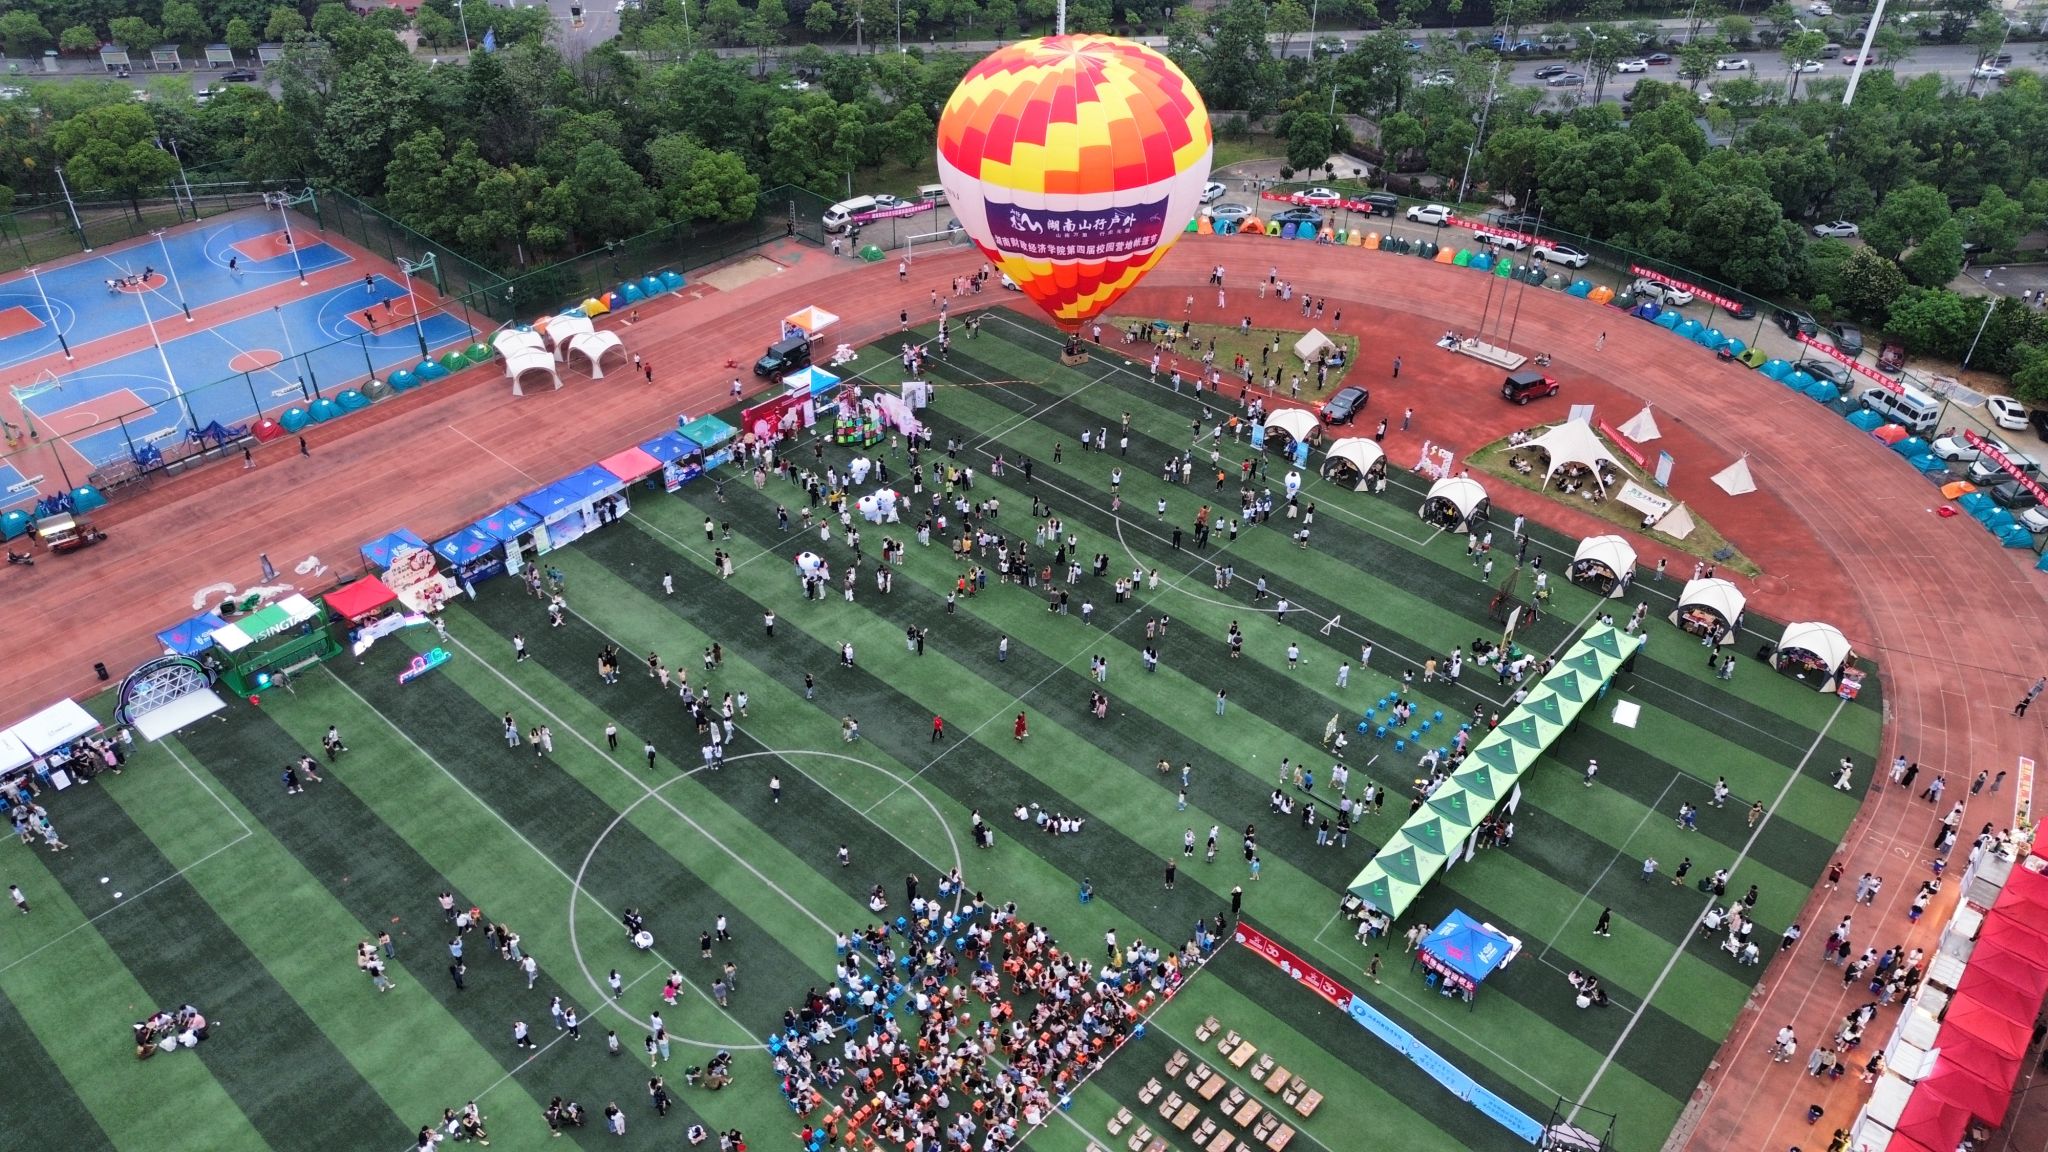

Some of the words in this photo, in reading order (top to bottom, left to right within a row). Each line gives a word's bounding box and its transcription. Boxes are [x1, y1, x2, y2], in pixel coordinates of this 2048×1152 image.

[1047, 213, 1136, 232] 湖南山行户外
[994, 233, 1158, 256] 湖南财政经济学院第四届校园营地帐篷节
